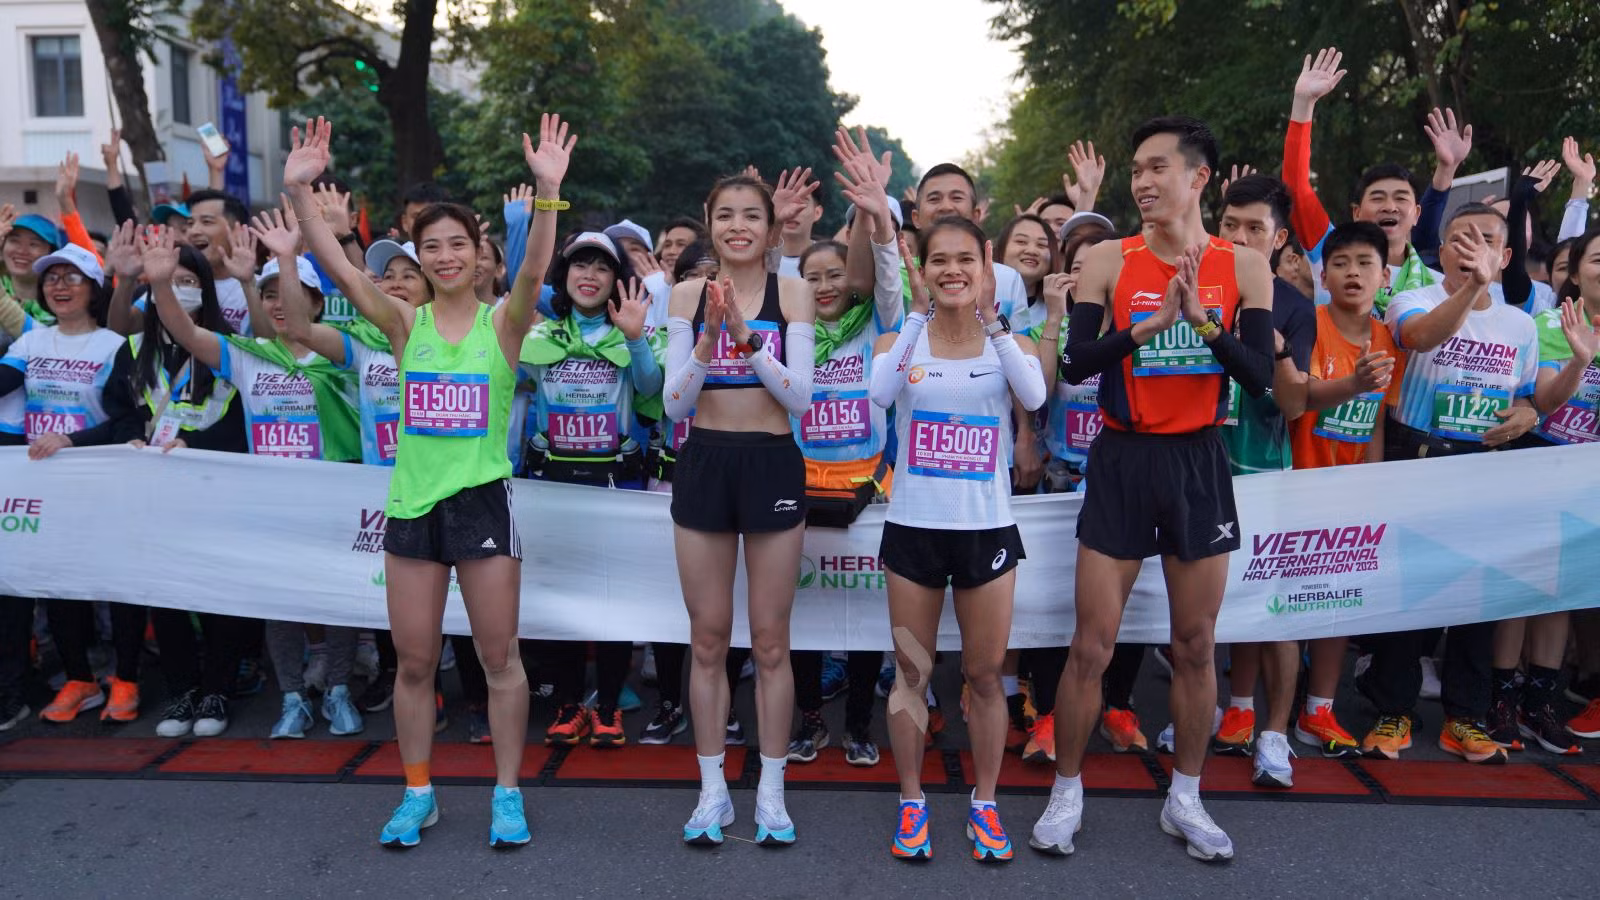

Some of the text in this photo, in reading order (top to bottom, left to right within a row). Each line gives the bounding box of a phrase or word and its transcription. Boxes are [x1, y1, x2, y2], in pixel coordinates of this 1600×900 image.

[1139, 321, 1204, 350] 1000
[1441, 336, 1518, 360] VIETNAM
[545, 370, 619, 380] INTERNATIONAL
[813, 367, 863, 380] RNATIONA
[1432, 357, 1454, 368] HALF
[1454, 361, 1500, 374] MARATHON
[409, 383, 481, 412] E15001
[1446, 394, 1500, 421] 11222
[810, 400, 860, 426] 16156
[1334, 400, 1378, 423] 11310
[28, 414, 75, 435] 16248
[259, 424, 309, 446] 16145
[556, 414, 608, 437] 16112
[915, 422, 992, 454] E15003
[0, 498, 43, 514] IFE
[361, 508, 389, 531] VI
[1253, 523, 1387, 556] VIETNAM
[1247, 548, 1378, 570] INTERNATIONAL
[1242, 560, 1379, 581] HALF MARATHON 2023
[1287, 598, 1363, 613] NUTRITION
[1288, 588, 1363, 603] HERBALIFE
